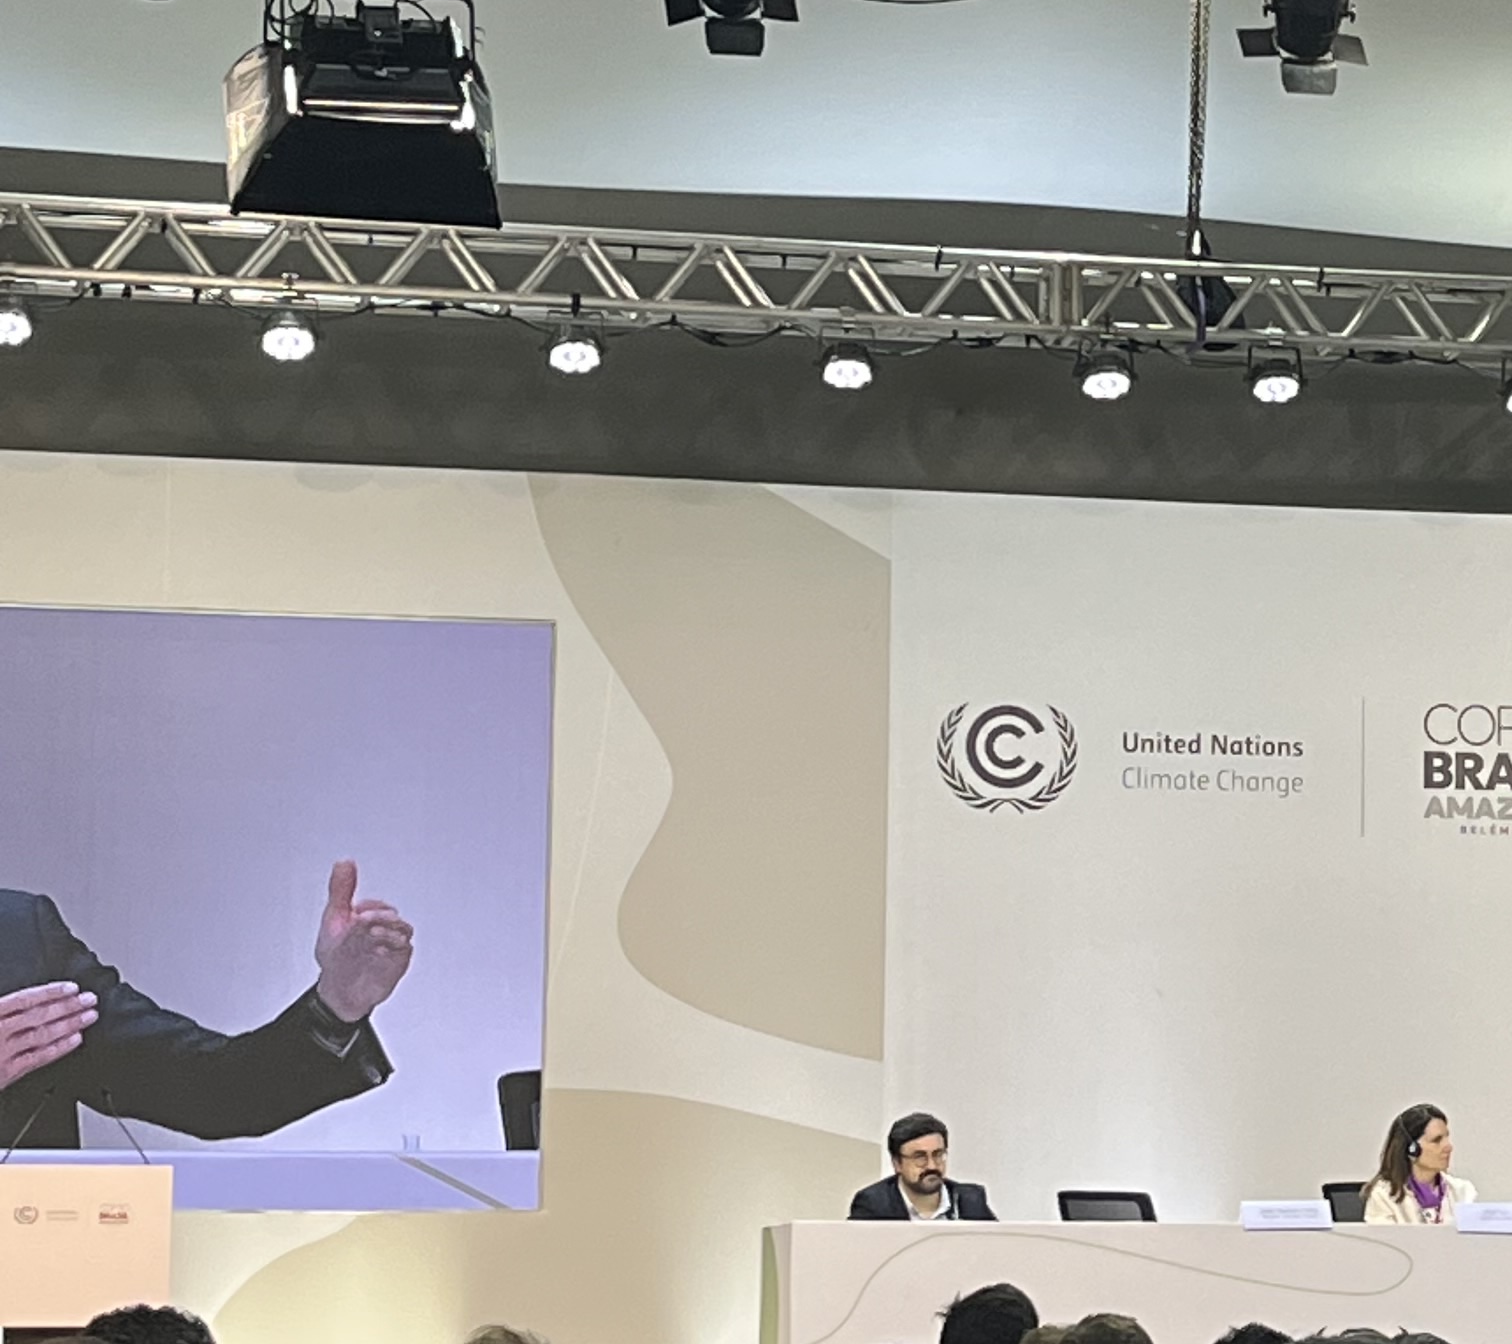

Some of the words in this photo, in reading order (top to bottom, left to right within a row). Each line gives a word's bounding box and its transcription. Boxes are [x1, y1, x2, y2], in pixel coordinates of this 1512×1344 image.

[1122, 732, 1201, 754] United
[1211, 734, 1304, 756] Nations
[1122, 767, 1210, 790] Climate
[1216, 769, 1304, 798] Change
